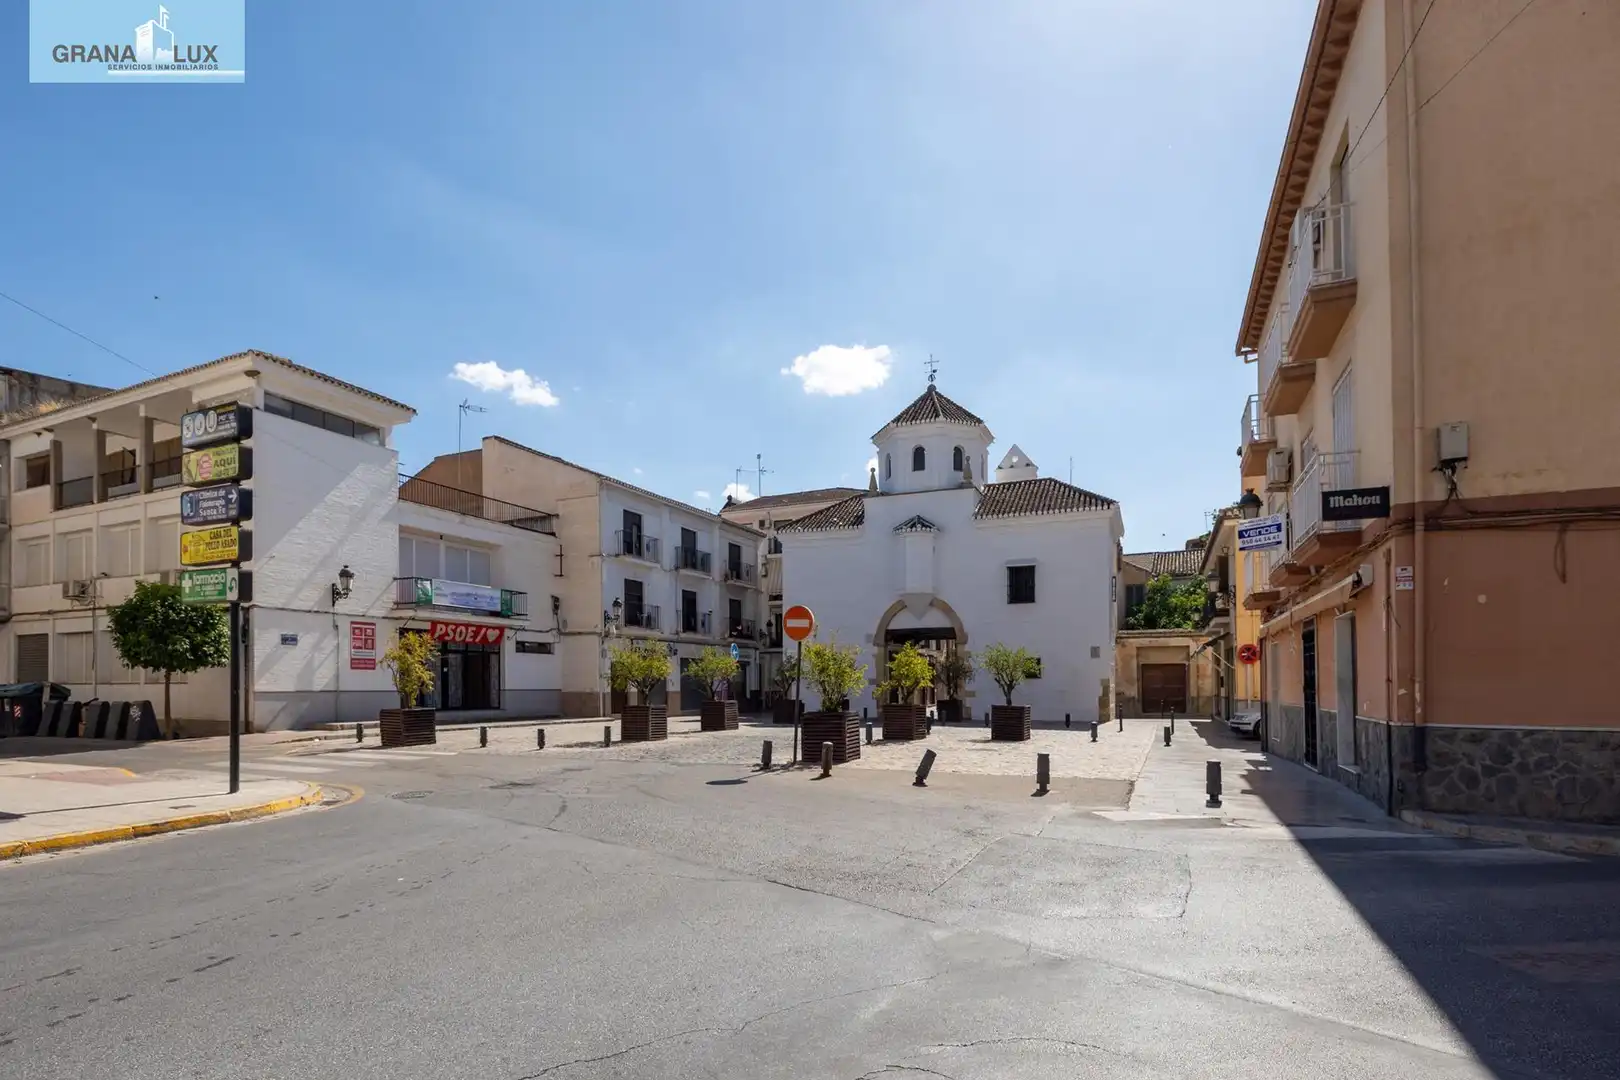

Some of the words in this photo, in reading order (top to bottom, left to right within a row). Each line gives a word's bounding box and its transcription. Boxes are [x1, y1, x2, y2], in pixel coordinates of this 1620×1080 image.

[1328, 494, 1381, 508] Mahou
[199, 507, 217, 517] Santa
[1242, 525, 1278, 537] VENDE
